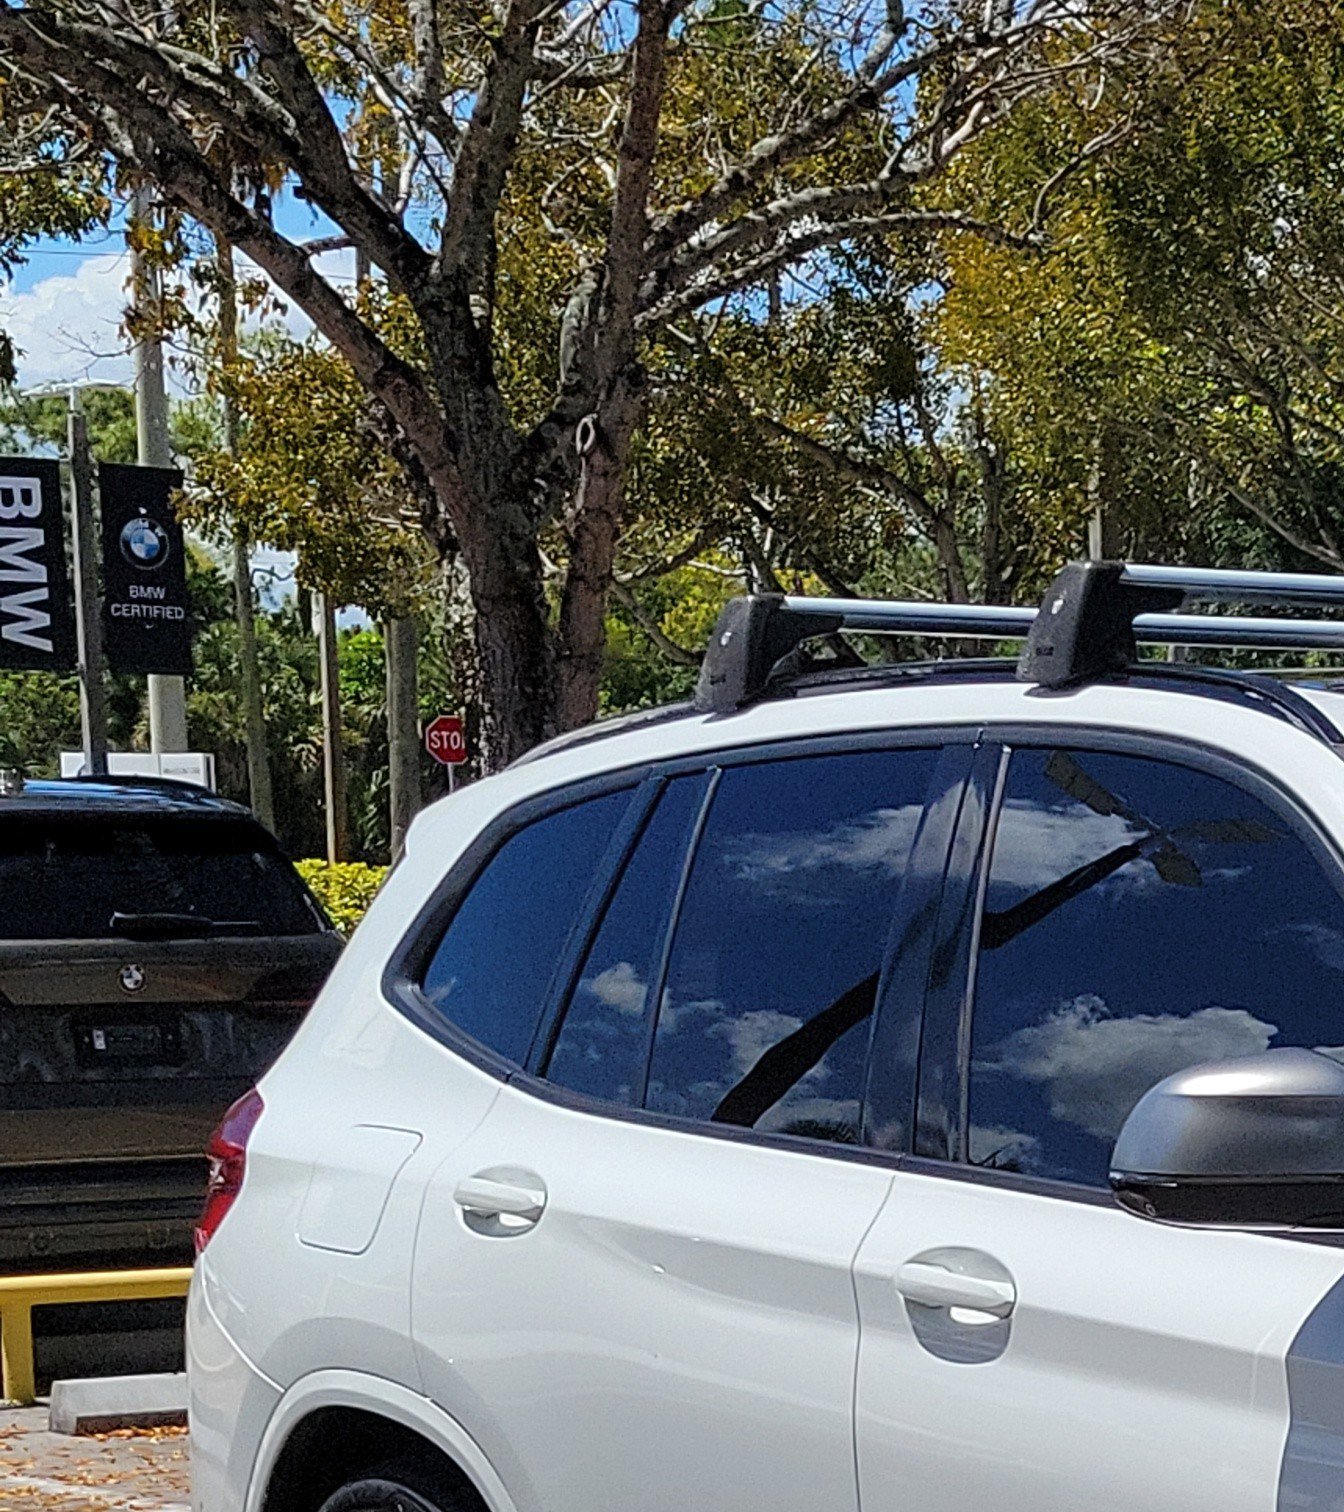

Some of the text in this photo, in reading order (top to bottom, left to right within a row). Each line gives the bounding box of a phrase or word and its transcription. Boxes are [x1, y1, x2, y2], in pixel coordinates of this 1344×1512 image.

[0, 475, 53, 652] BMW
[129, 585, 166, 599] BMW
[110, 603, 185, 620] CERTIFIED
[430, 730, 465, 750] STO
